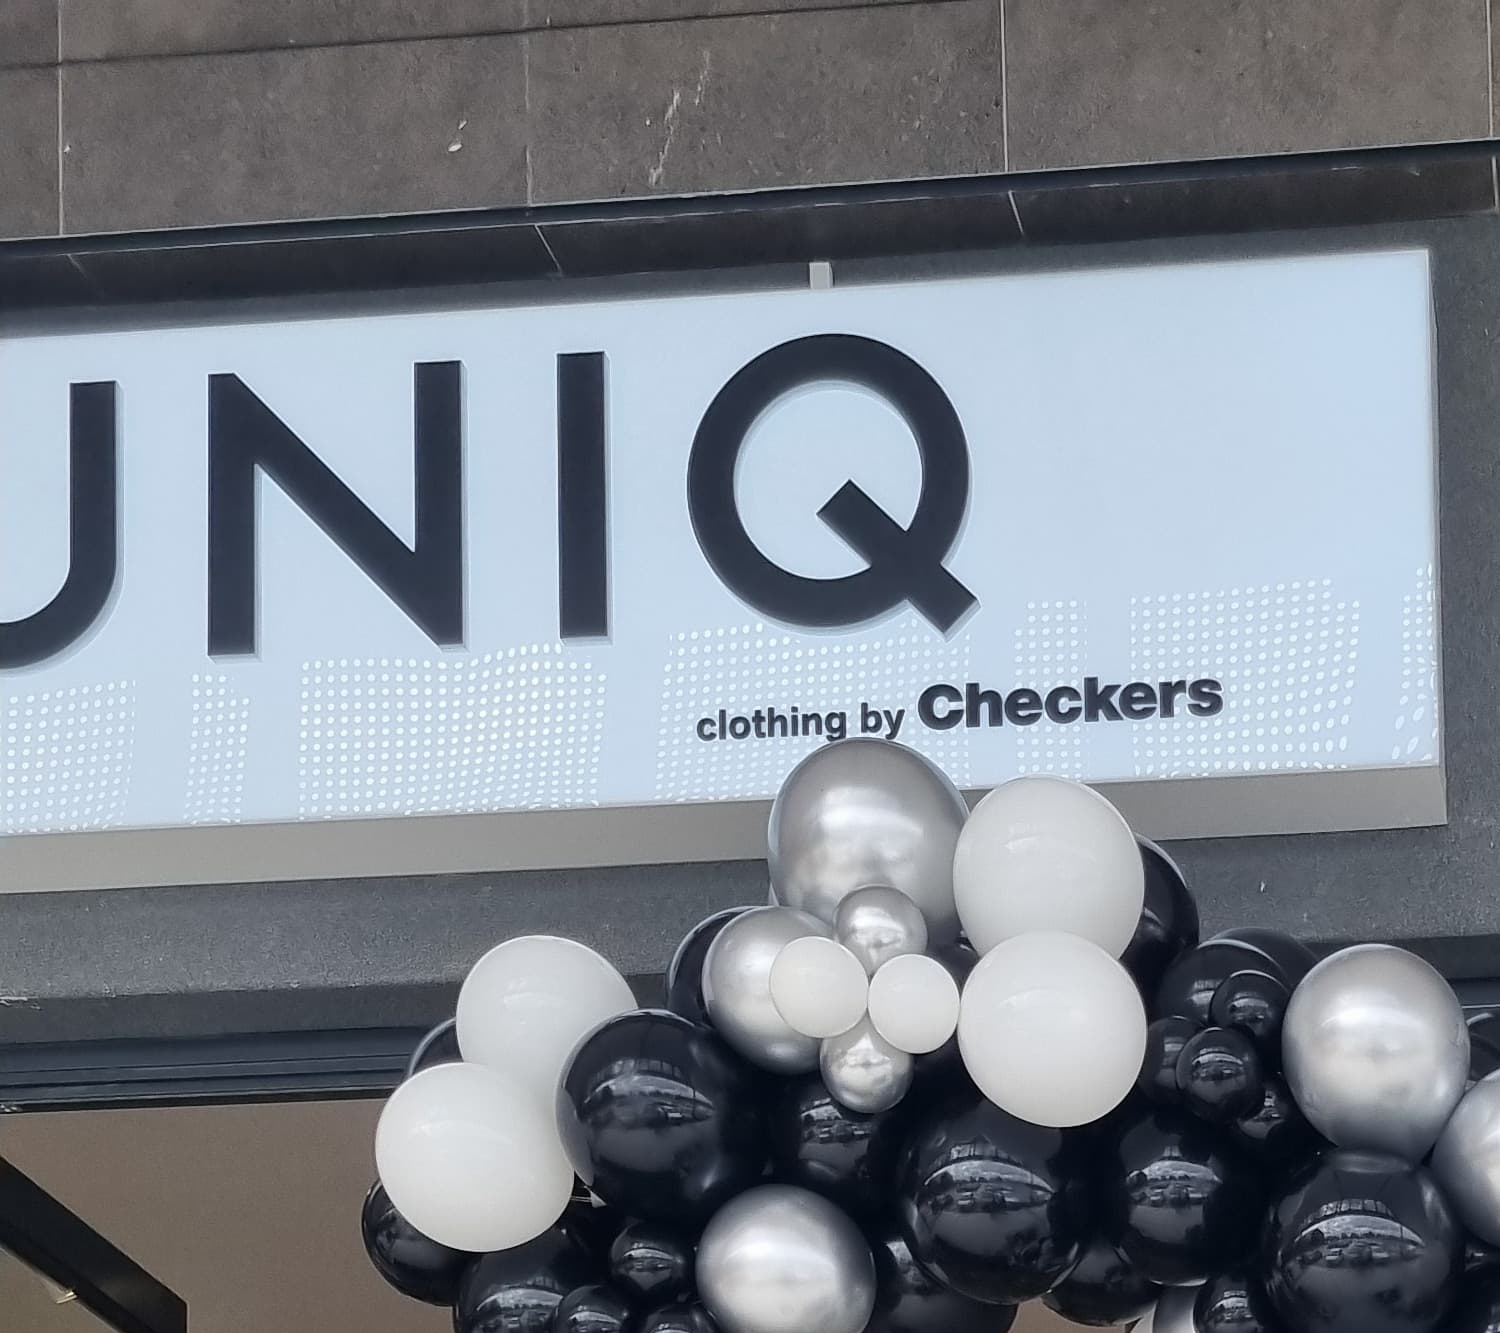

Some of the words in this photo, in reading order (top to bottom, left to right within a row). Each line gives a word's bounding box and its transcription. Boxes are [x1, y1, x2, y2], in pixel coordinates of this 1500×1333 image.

[695, 706, 848, 742] clothing
[860, 702, 906, 740] by
[917, 676, 1223, 730] Checkers
